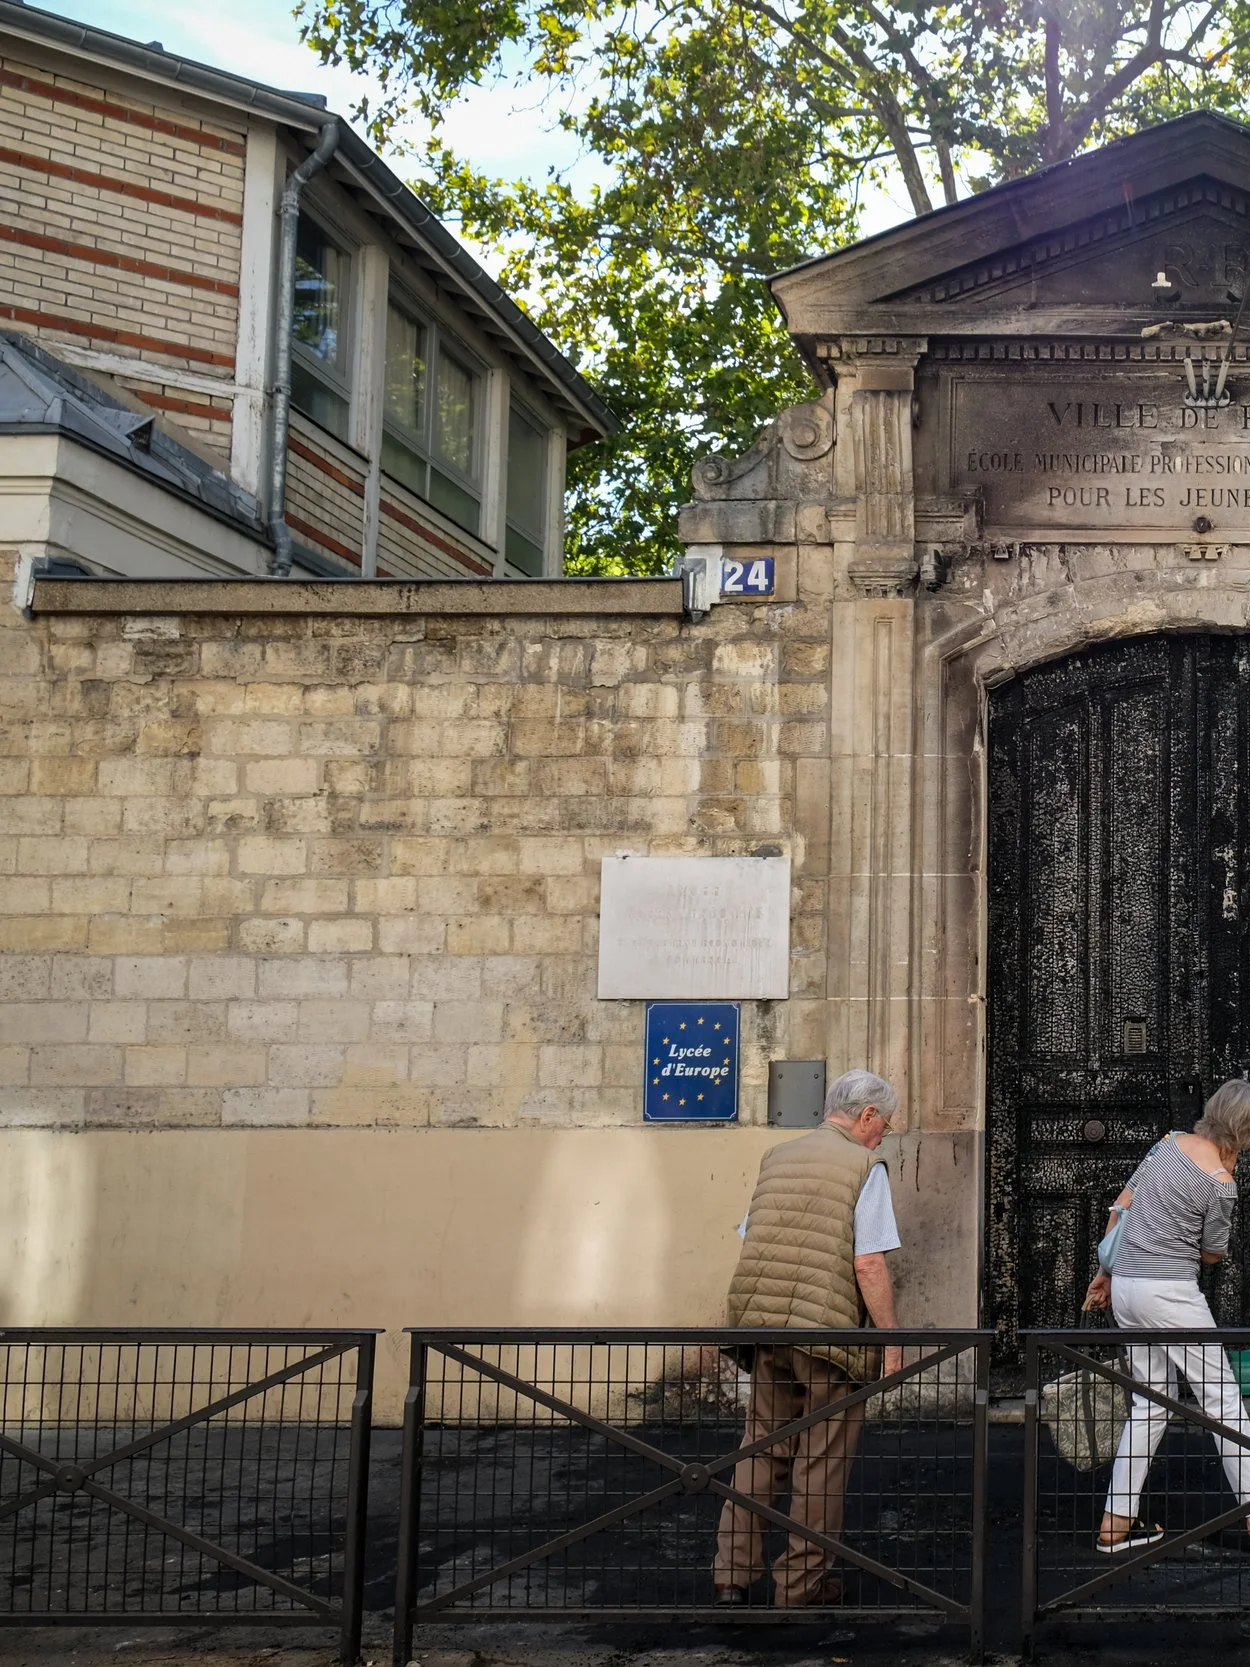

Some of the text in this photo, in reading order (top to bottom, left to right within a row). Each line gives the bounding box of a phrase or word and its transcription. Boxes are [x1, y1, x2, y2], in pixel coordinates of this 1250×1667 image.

[1047, 402, 1159, 429] VILLE
[1179, 406, 1220, 430] DE
[967, 449, 1024, 473] ÉCOLE
[1034, 453, 1142, 474] MUNICIPALE
[1047, 486, 1112, 508] POUR
[1125, 487, 1166, 508] LES
[724, 559, 769, 592] 24
[668, 1043, 712, 1060] Lycée
[661, 1062, 729, 1079] d'Europe
